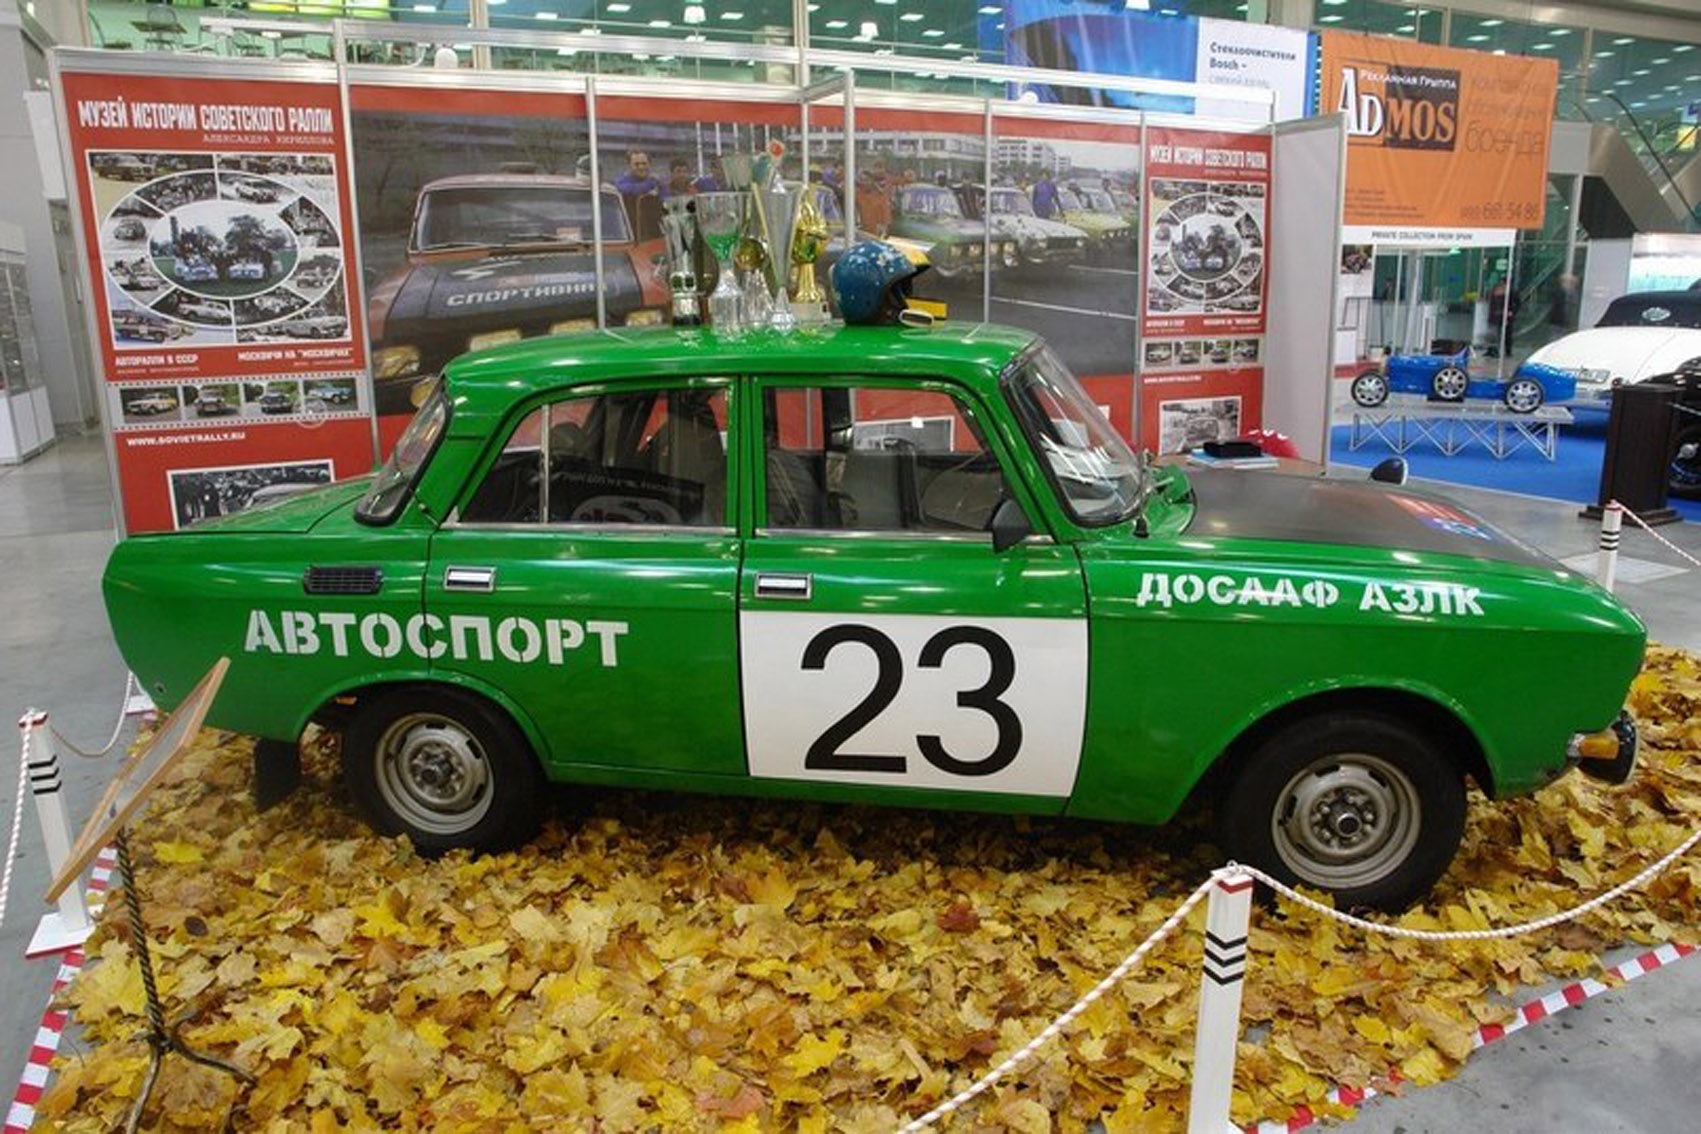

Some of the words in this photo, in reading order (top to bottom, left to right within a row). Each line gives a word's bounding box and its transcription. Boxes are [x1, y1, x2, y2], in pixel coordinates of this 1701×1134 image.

[1209, 57, 1239, 70] Bosch
[78, 96, 129, 128] МУЗЕЙ
[131, 103, 197, 131] ИСТОРИИ
[200, 104, 285, 132] СОВЕТСКОГО
[289, 107, 334, 133] РАЛЛИ
[1136, 572, 1340, 609] ДОСААФ
[1359, 580, 1485, 616] АЗЛК
[243, 608, 630, 667] АВТОСПОРТ
[800, 623, 1023, 777] 23
